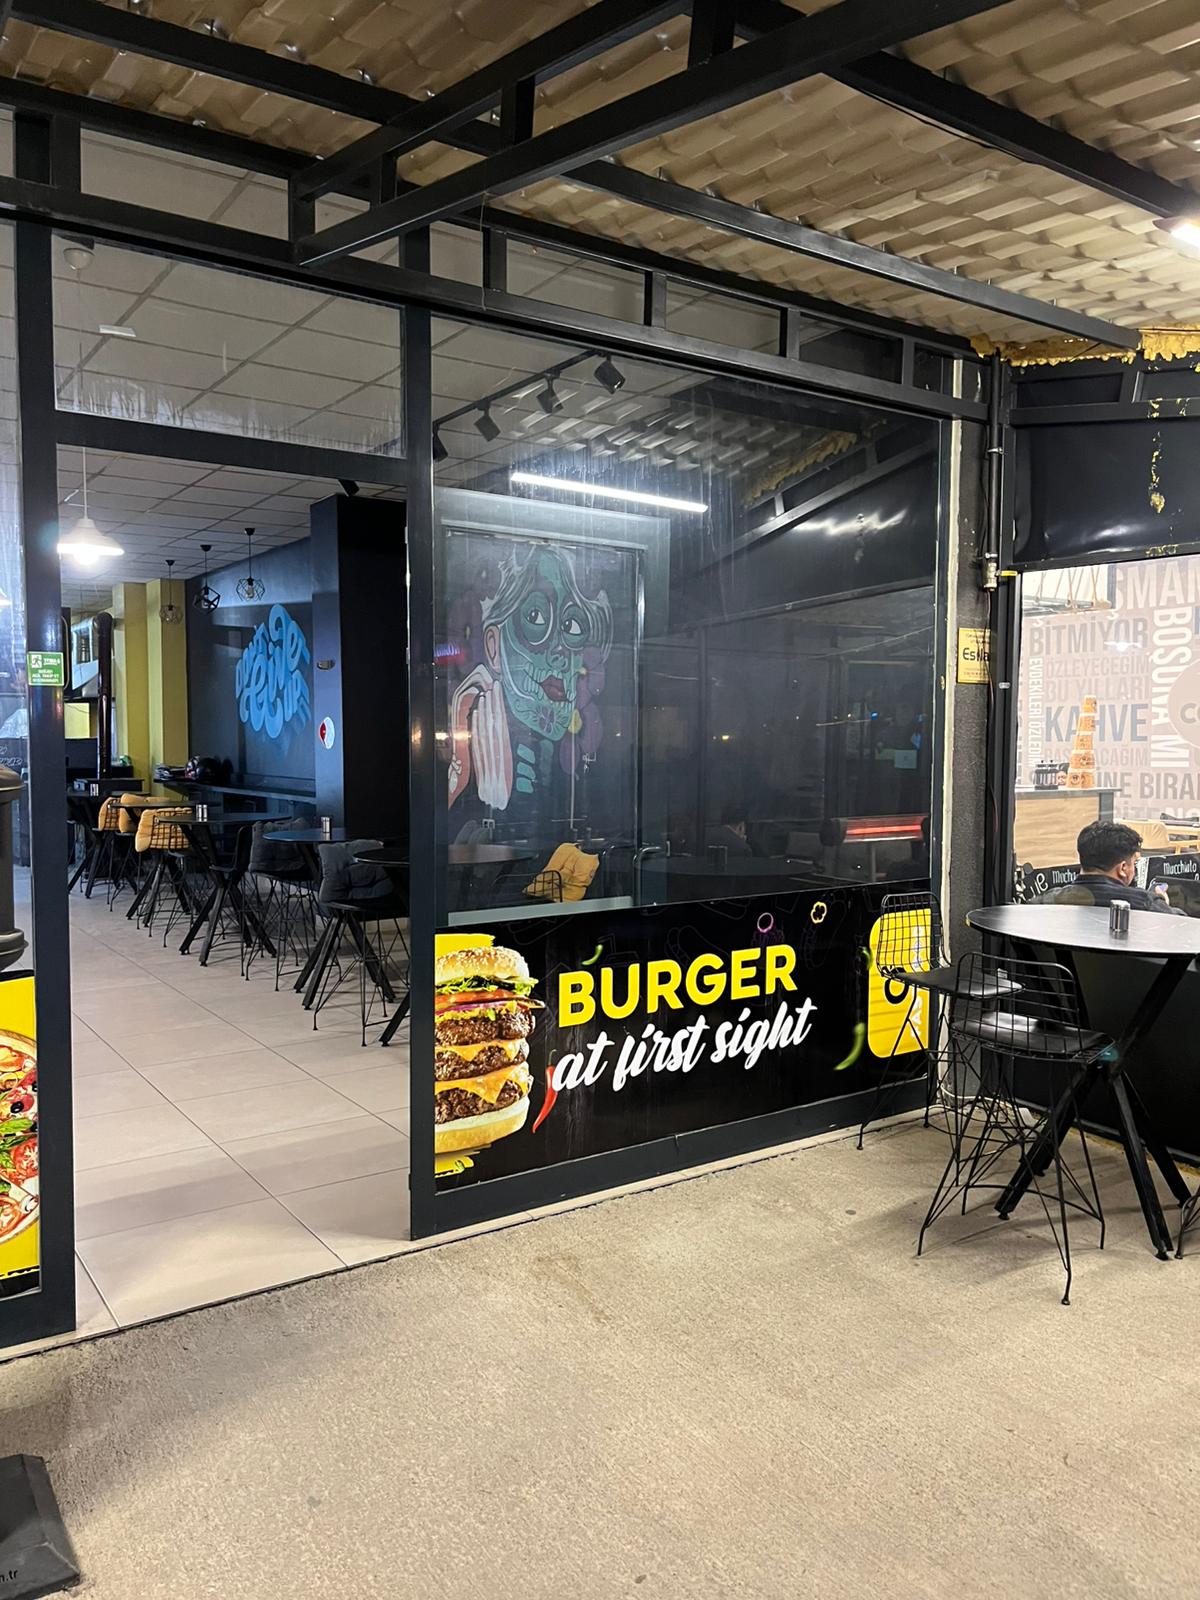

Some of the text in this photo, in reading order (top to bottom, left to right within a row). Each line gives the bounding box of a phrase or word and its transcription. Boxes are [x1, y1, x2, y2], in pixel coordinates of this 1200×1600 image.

[1139, 771, 1200, 800] BIRA
[559, 943, 798, 1028] BURGER
[551, 997, 818, 1092] at first sight
